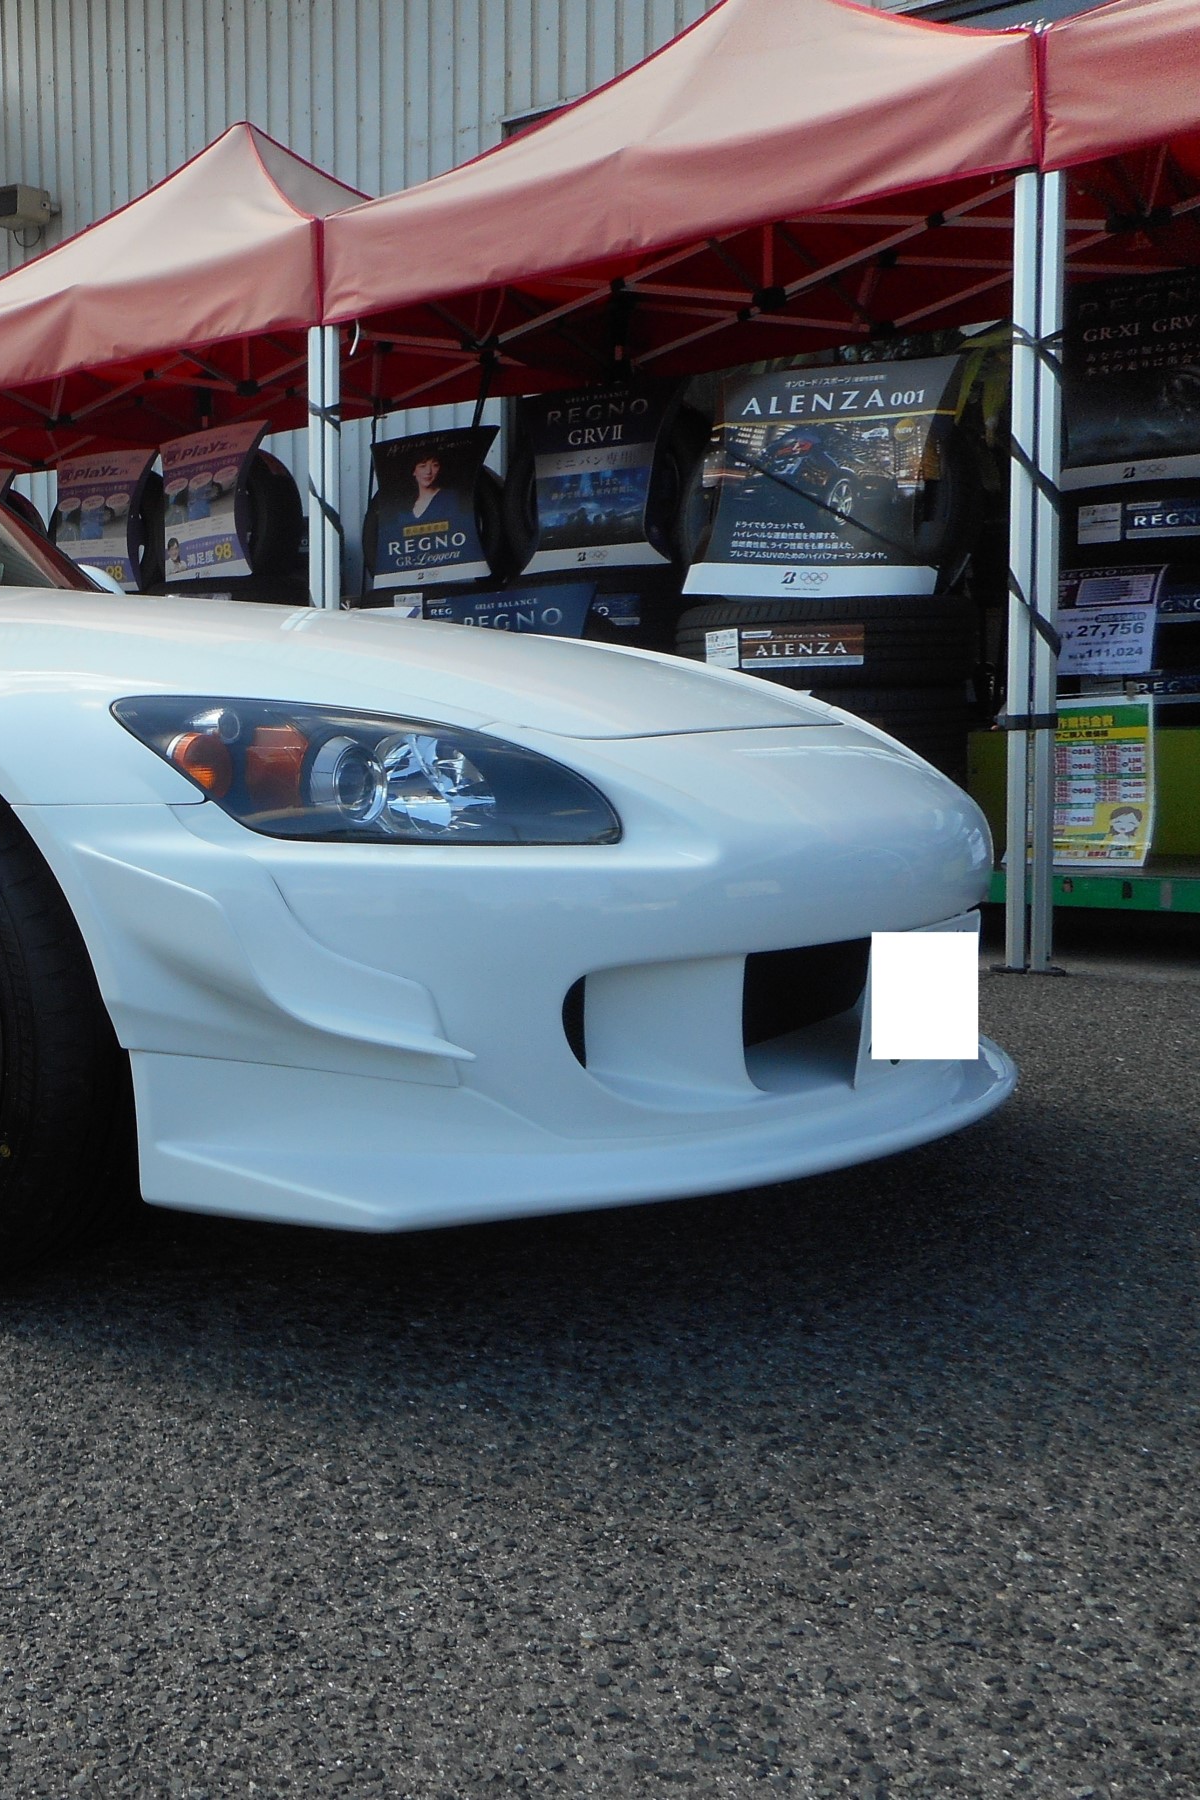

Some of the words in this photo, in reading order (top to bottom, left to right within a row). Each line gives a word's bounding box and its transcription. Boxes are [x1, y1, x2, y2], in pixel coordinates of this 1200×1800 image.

[1083, 321, 1140, 342] GR-XI
[741, 388, 885, 416] ALENZA
[890, 389, 925, 407] 001
[546, 398, 649, 427] REGNO
[735, 521, 806, 530] ドライでもウェットでも
[1133, 512, 1200, 527] REGN
[388, 532, 467, 556] REGNO
[395, 551, 461, 567] GR-Leggera
[475, 602, 495, 611] GREAT
[498, 598, 538, 608] BALANCE
[755, 641, 847, 657] ALENZA
